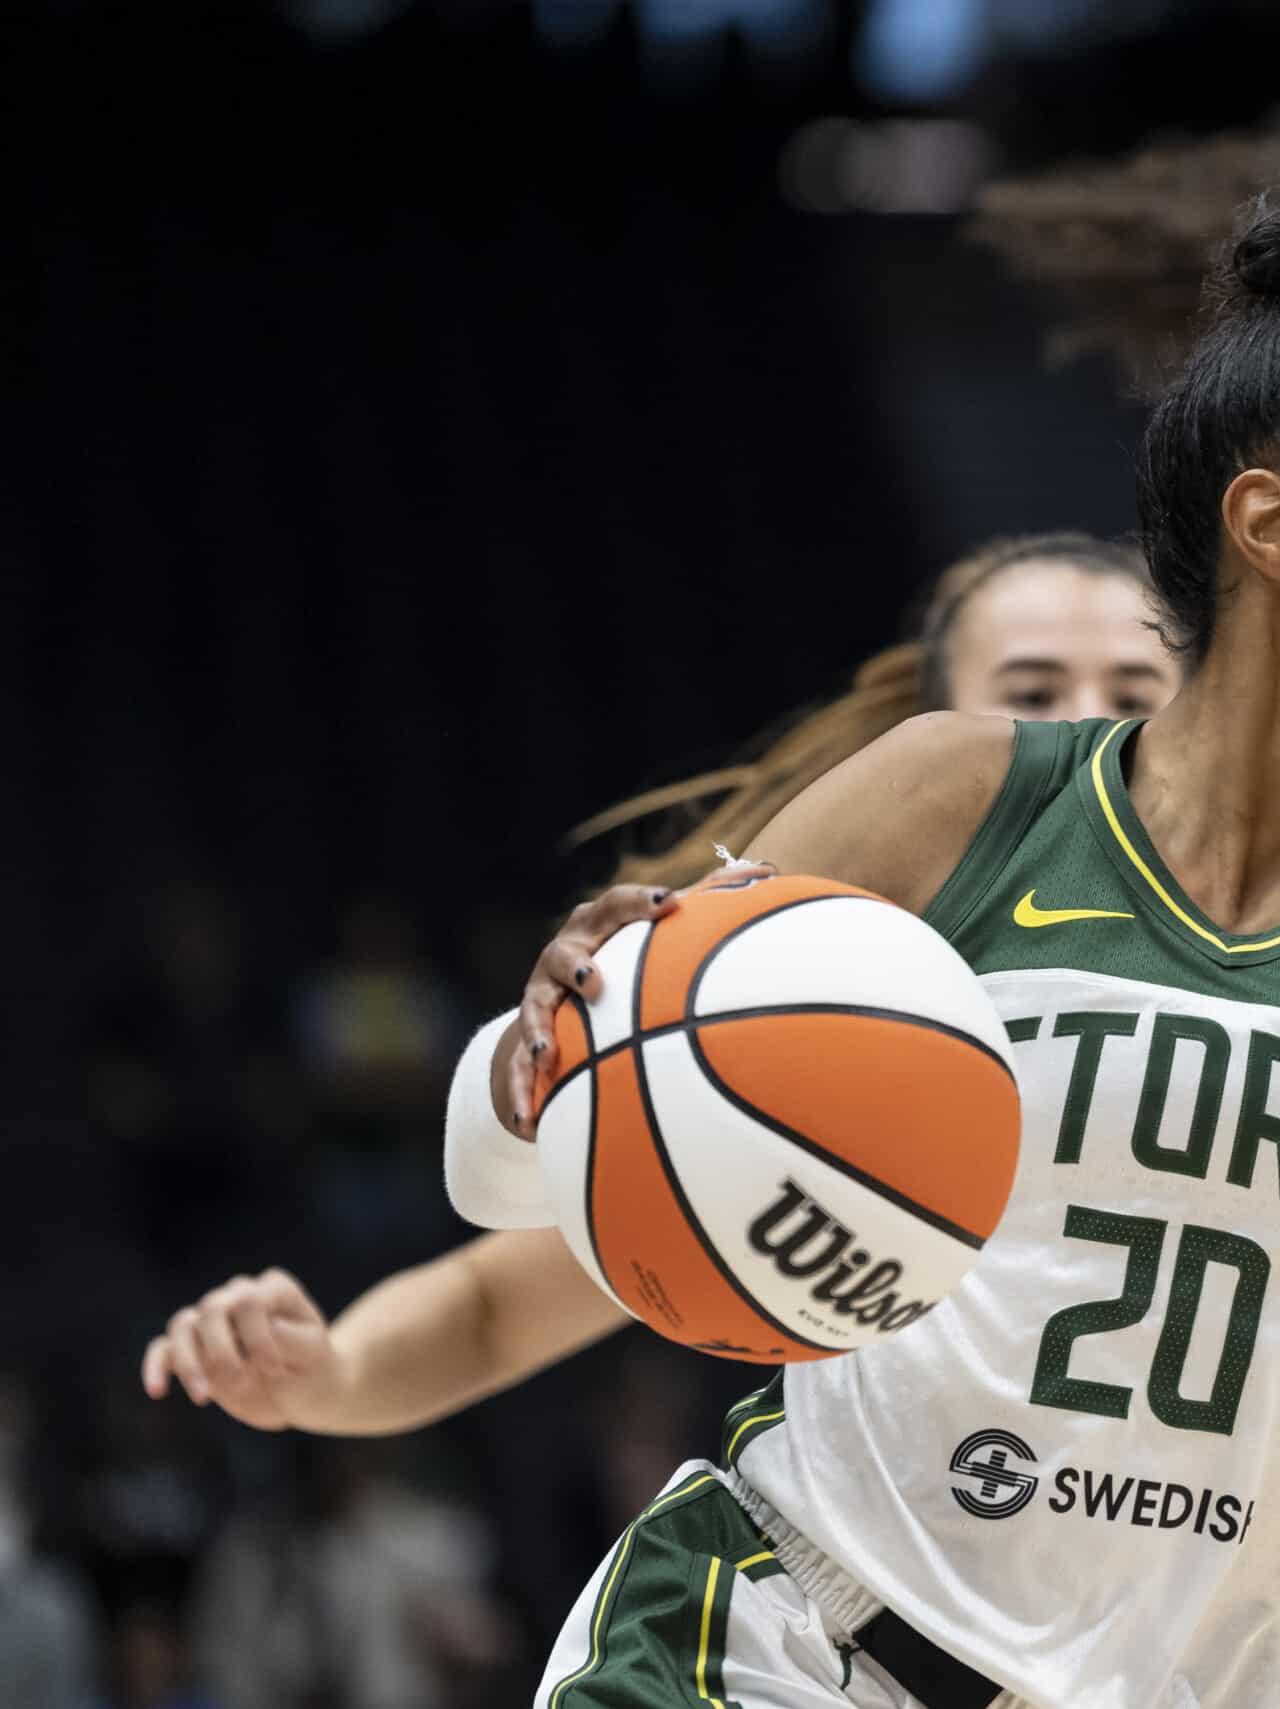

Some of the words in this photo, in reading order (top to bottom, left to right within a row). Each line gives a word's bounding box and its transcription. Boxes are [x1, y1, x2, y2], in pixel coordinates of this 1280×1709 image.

[747, 1177, 938, 1333] Wilso
[1029, 1204, 1271, 1436] 20
[1048, 1467, 1254, 1545] SWEDIS
